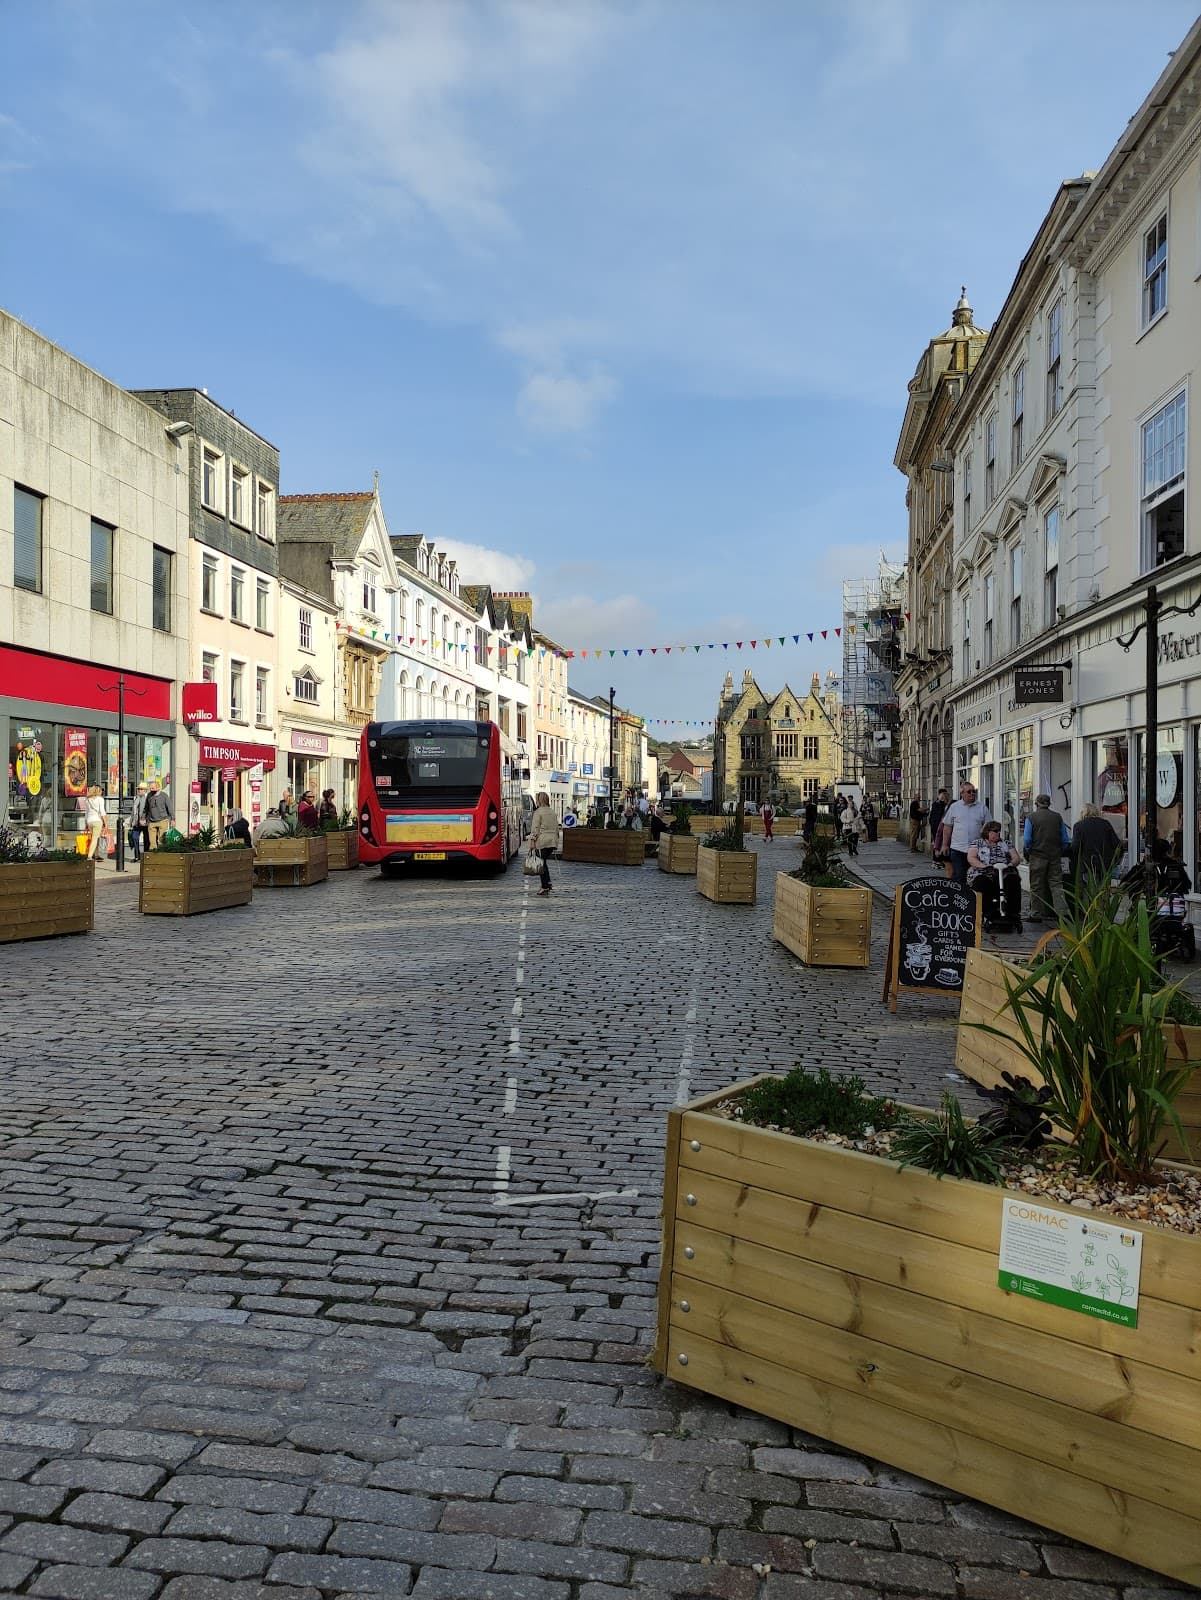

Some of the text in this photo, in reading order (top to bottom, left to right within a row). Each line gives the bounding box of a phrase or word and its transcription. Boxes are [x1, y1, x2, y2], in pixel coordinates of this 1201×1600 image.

[1020, 680, 1058, 688] ERNEST
[1023, 687, 1056, 695] JONES
[187, 709, 213, 720] wilko
[203, 746, 241, 761] TIMPSON
[931, 911, 974, 932] BOOKS
[1008, 1205, 1070, 1230] CORMAC
